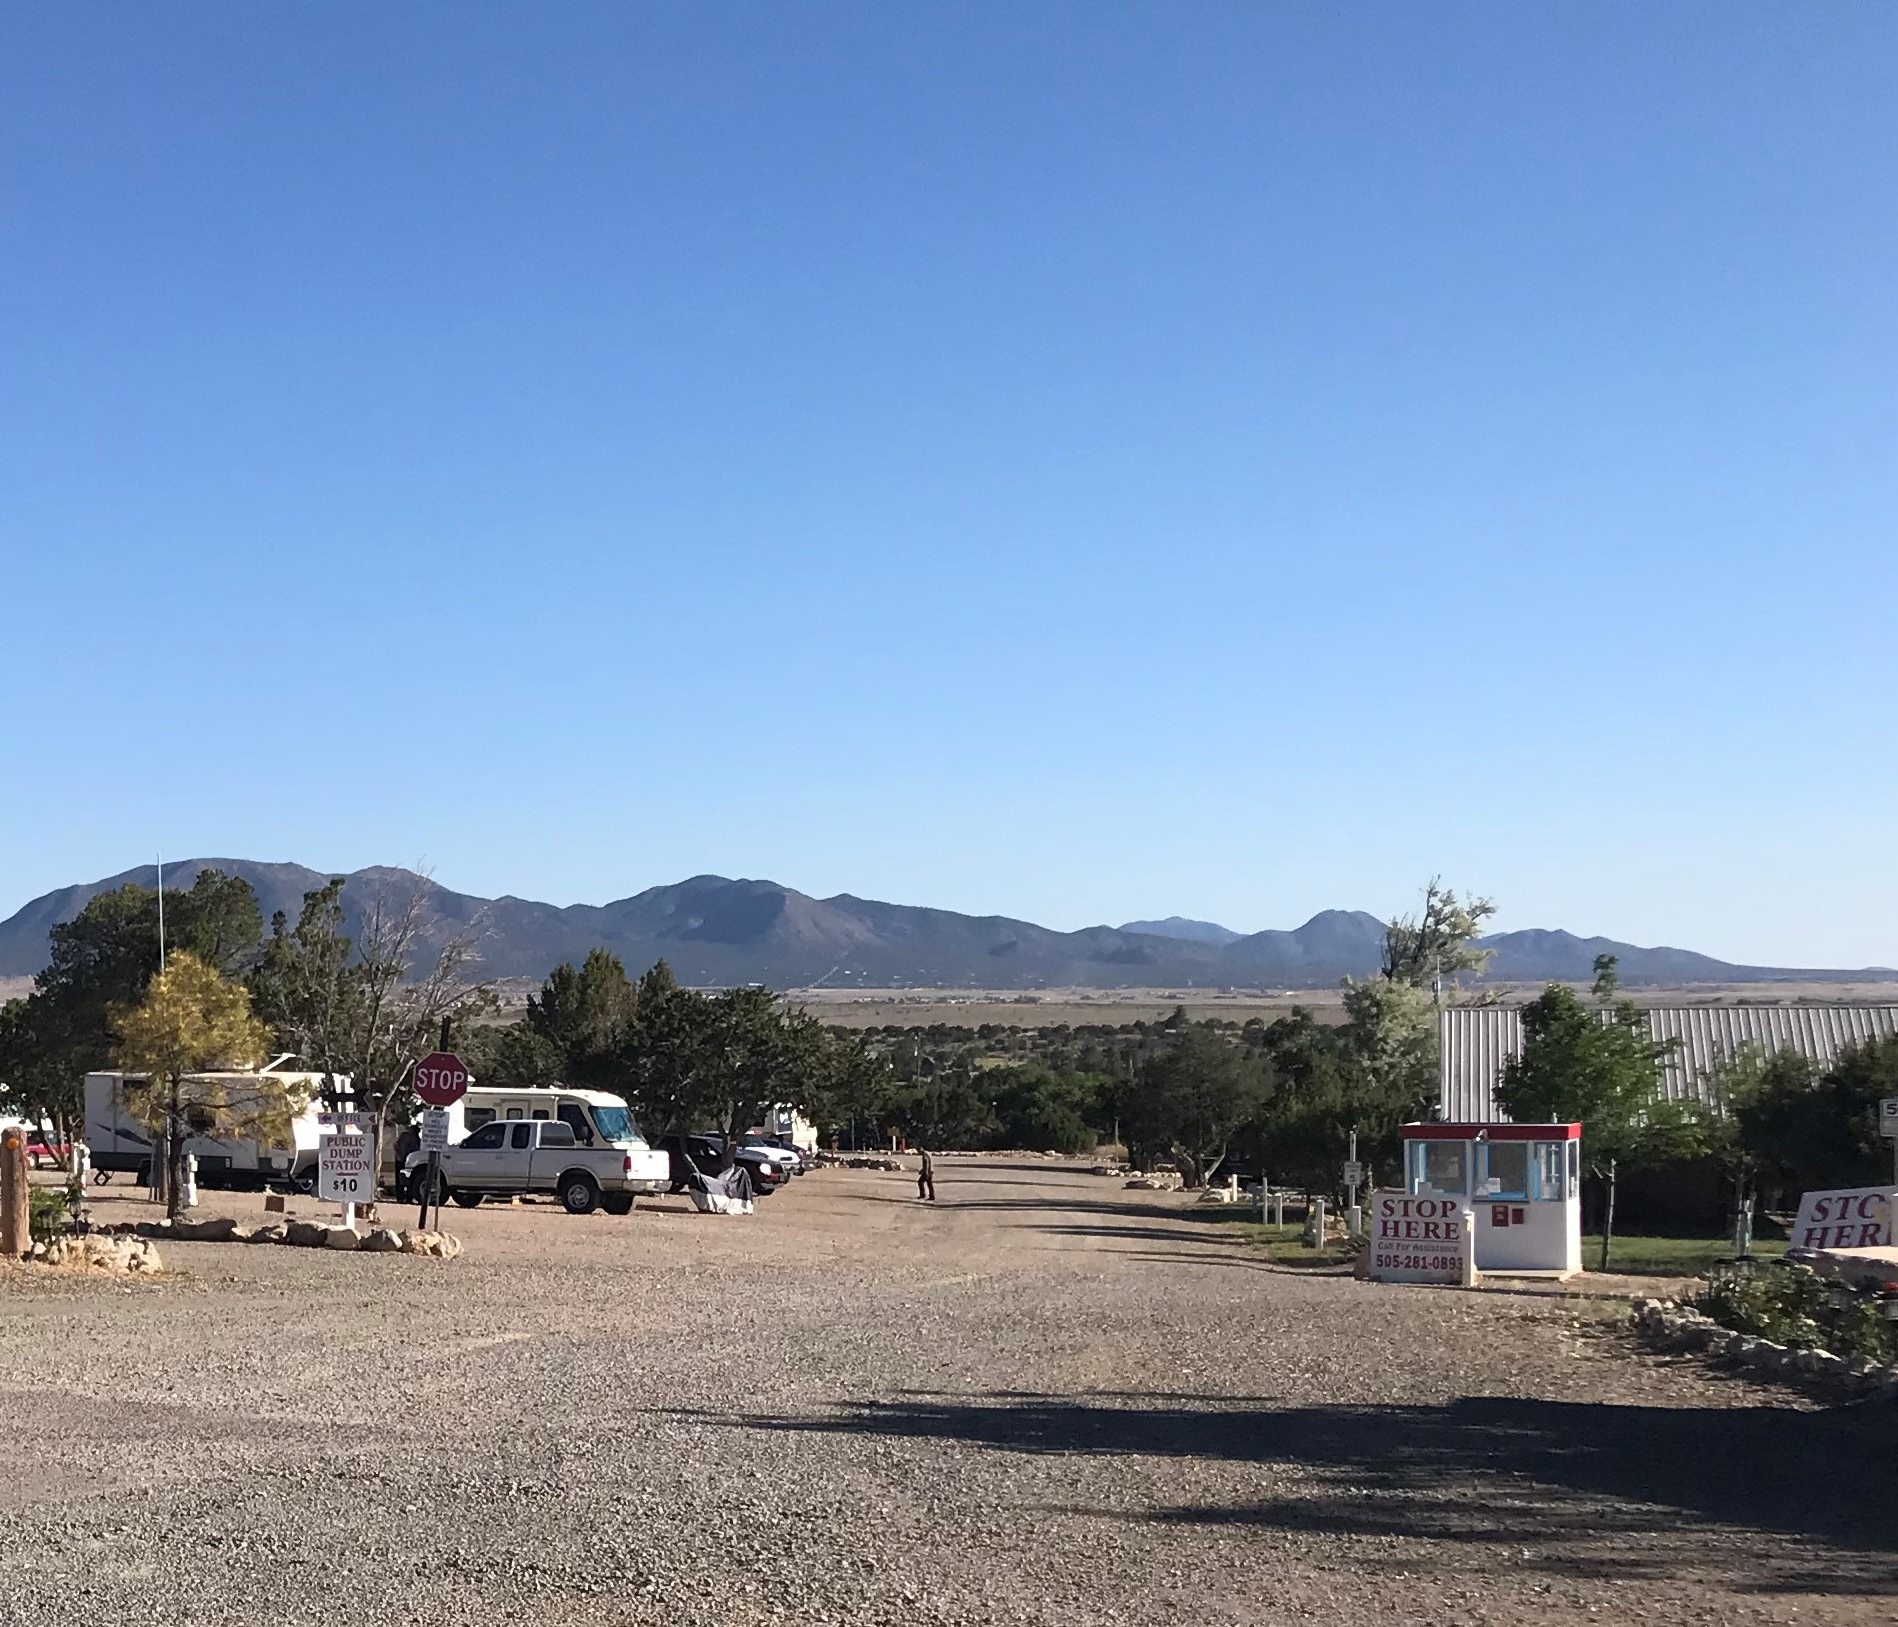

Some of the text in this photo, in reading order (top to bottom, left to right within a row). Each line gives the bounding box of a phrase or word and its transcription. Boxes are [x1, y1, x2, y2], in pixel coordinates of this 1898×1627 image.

[416, 1068, 465, 1090] STOP
[327, 1137, 366, 1147] PUBLIC
[330, 1149, 363, 1159] DUMP
[322, 1160, 370, 1171] STATION
[333, 1178, 358, 1192] $10
[1381, 1199, 1457, 1218] STOP
[1380, 1220, 1460, 1240] HERE
[1377, 1241, 1394, 1251] Call
[1396, 1242, 1411, 1252] For
